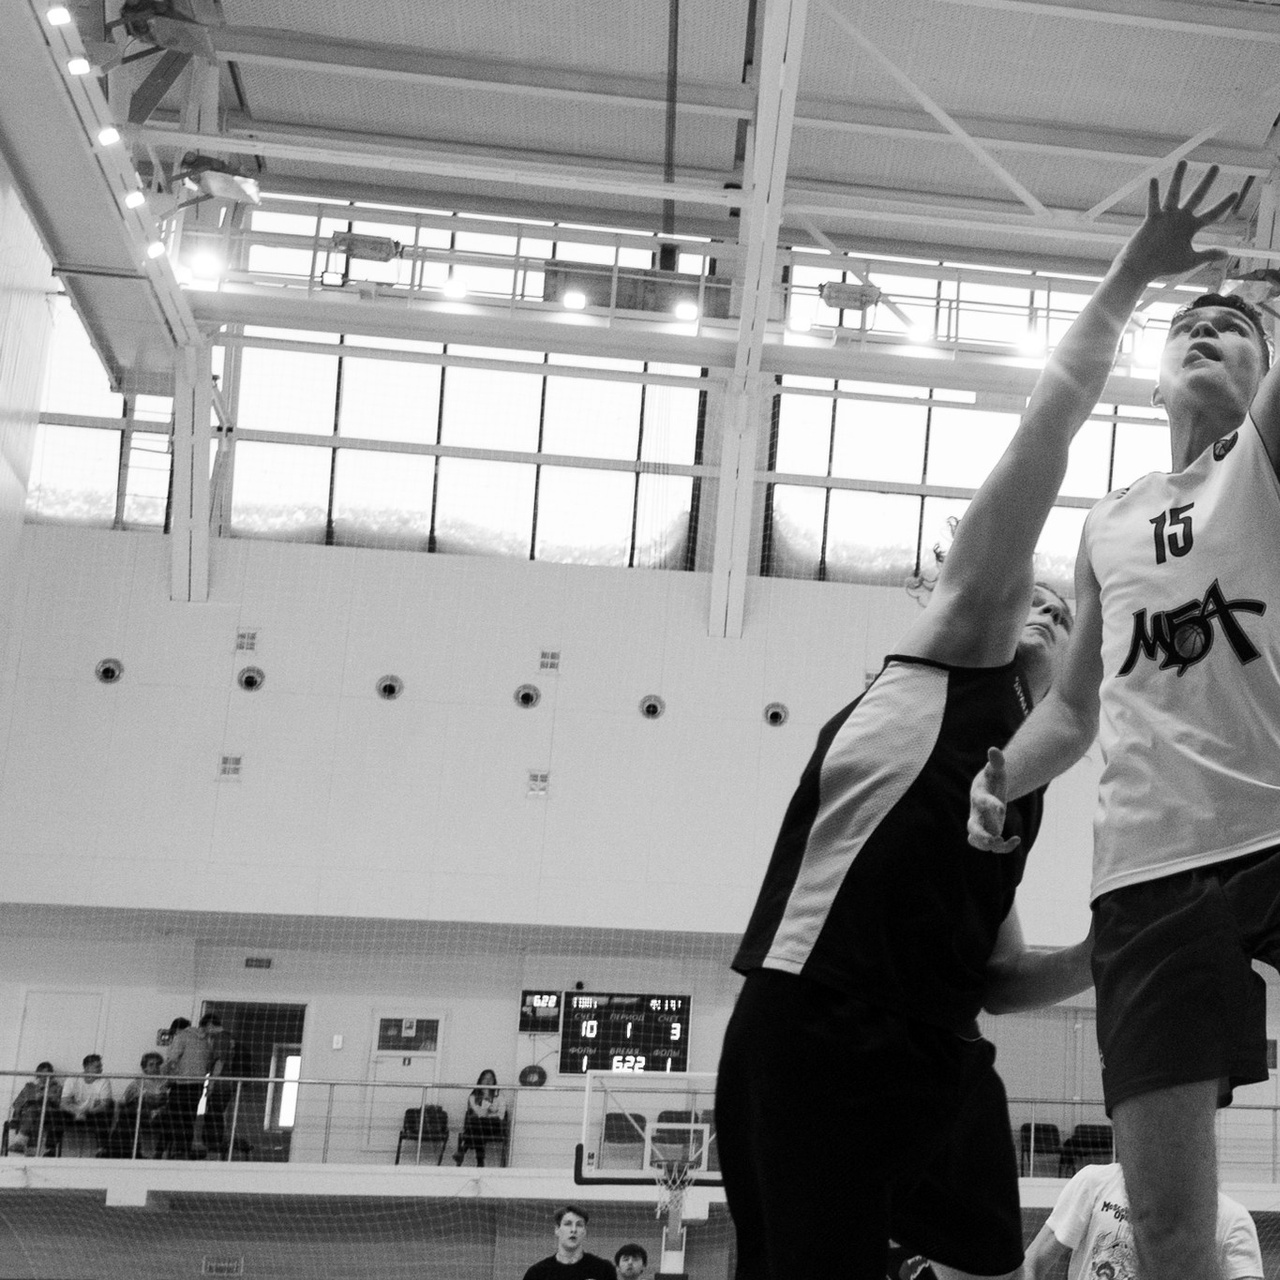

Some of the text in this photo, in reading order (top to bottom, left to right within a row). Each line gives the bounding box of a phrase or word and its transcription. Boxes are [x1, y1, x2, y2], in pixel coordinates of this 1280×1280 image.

[1149, 501, 1194, 565] 15
[609, 1013, 645, 1021] ПЕРИОД
[581, 1020, 681, 1040] 10 1 3
[569, 1046, 681, 1057] ФОЛЫ ВРЕМЯ ФОЛЫ
